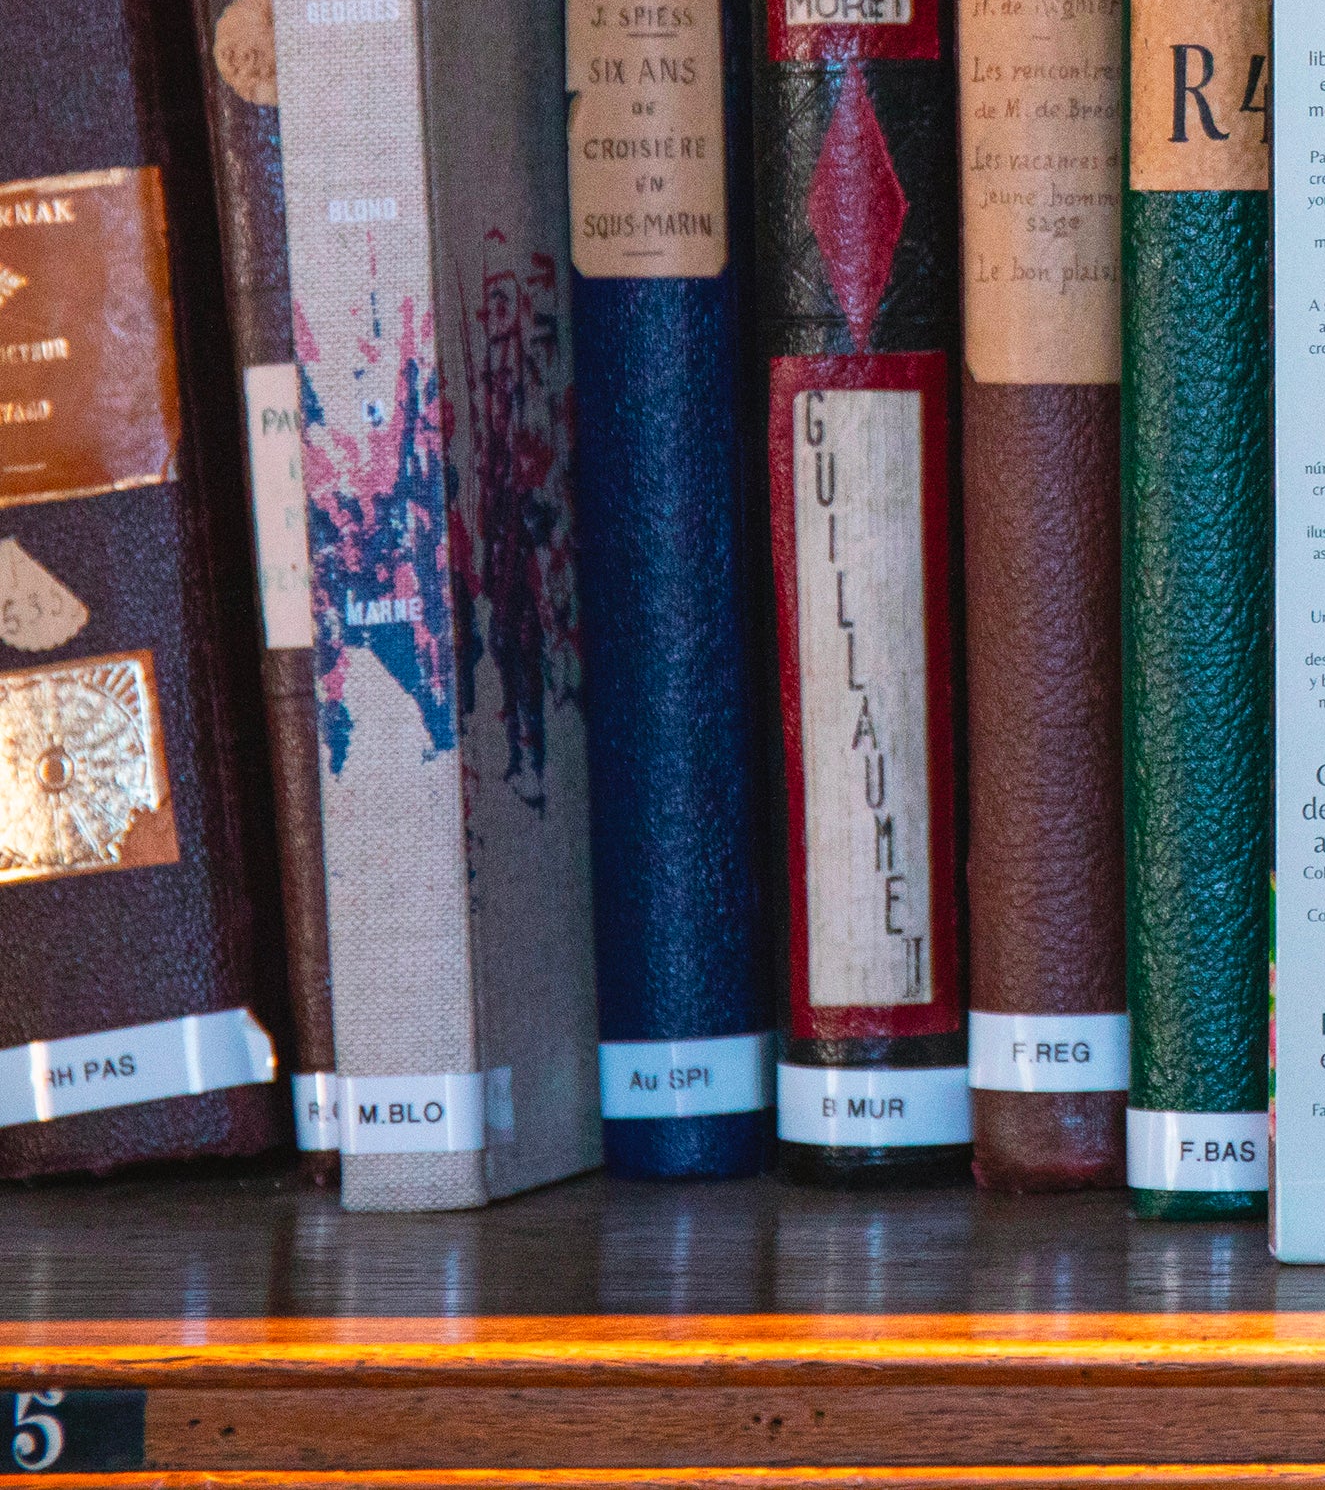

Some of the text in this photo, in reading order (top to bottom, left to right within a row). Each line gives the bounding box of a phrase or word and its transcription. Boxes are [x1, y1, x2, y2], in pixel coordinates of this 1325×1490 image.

[618, 6, 695, 29] SPIESS
[588, 58, 698, 85] SIX ANS
[970, 56, 1003, 83] Les
[1168, 43, 1231, 144] R
[973, 99, 997, 121] de
[1034, 100, 1061, 121] de
[970, 144, 1001, 172] Les
[978, 188, 1036, 210] jeune
[974, 254, 1001, 284] Le
[1011, 256, 1053, 284] bon
[346, 595, 424, 627] MARNE
[805, 389, 907, 937] GUILLAUME
[1011, 1040, 1092, 1065] F.REG
[83, 1054, 137, 1082] PAS
[628, 1067, 712, 1092] Au SPI
[357, 1101, 444, 1126] M.BLO
[822, 1096, 906, 1119] B MUR
[1179, 1139, 1258, 1164] F.BAS
[12, 1388, 65, 1471] 5
